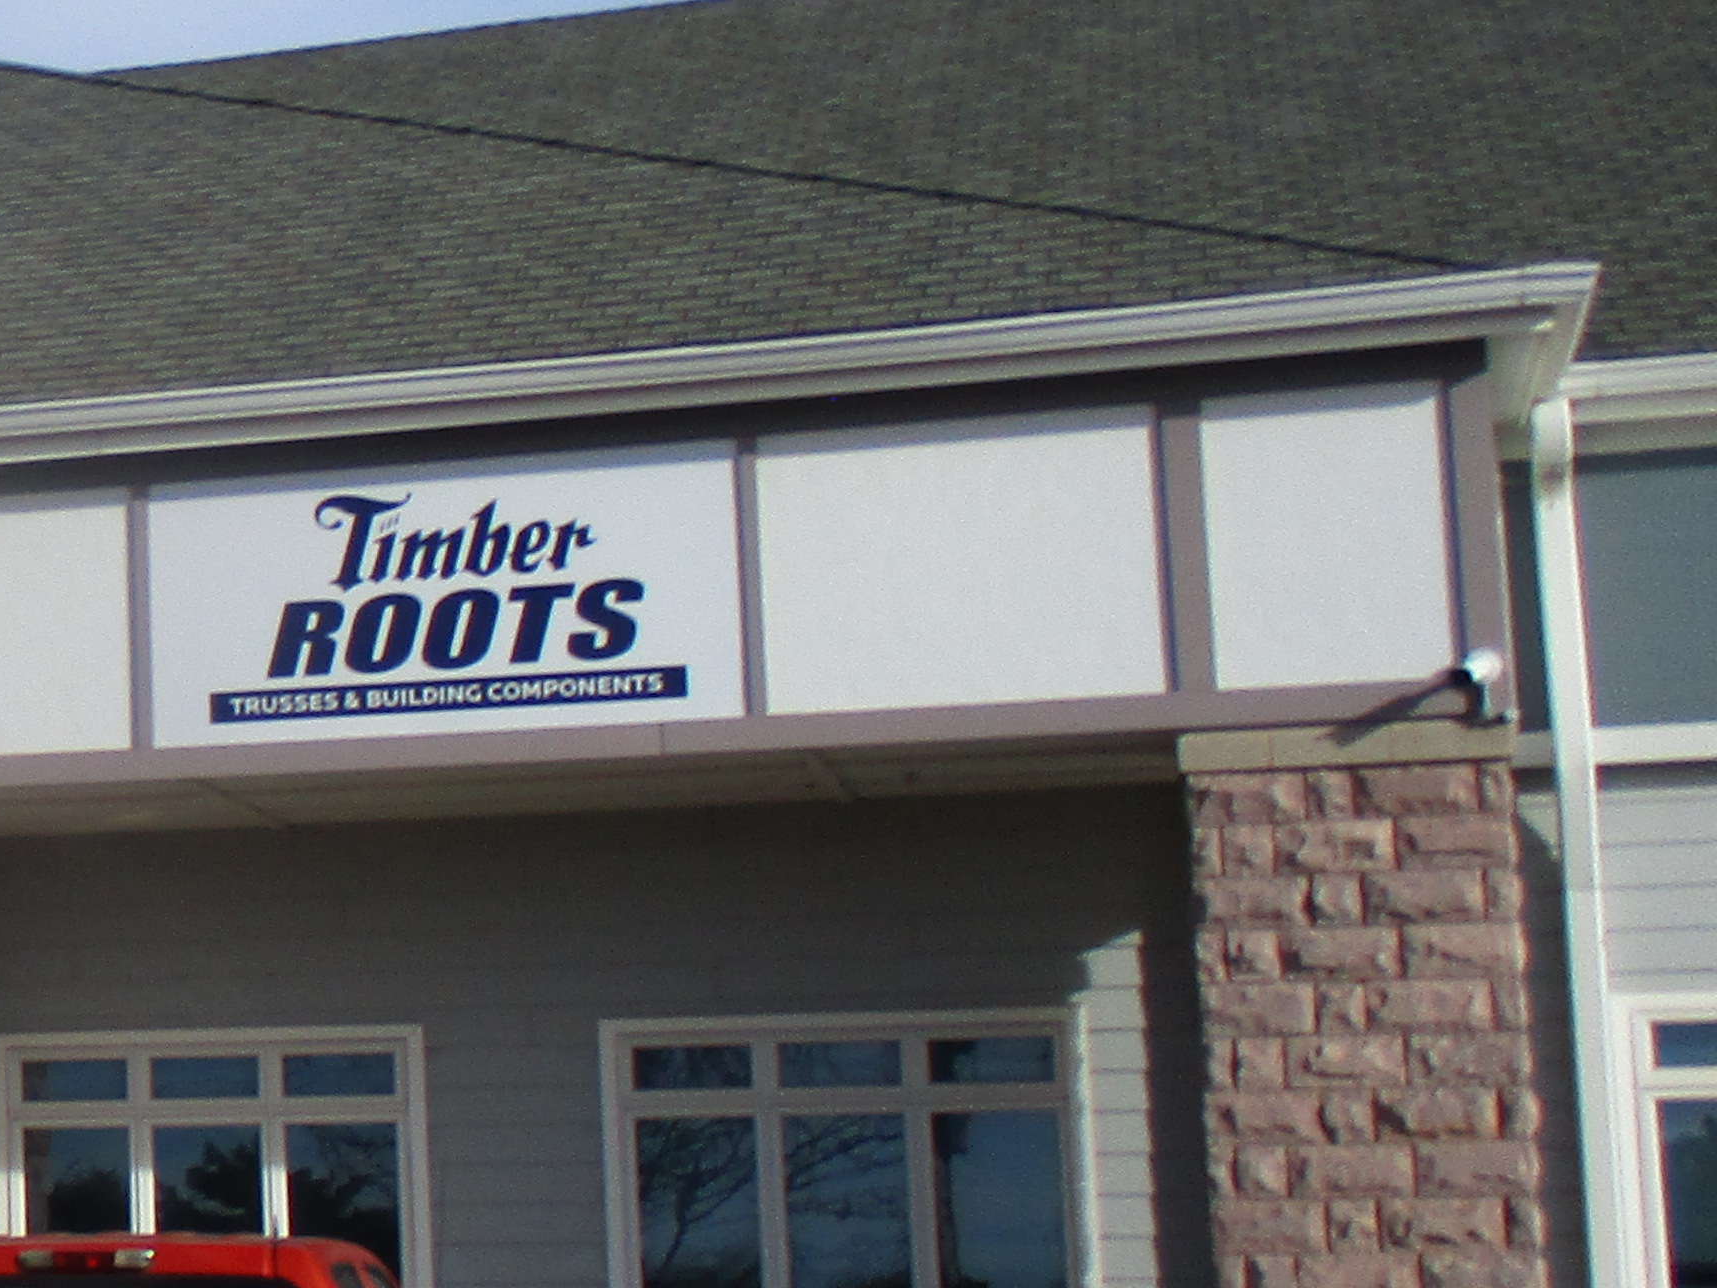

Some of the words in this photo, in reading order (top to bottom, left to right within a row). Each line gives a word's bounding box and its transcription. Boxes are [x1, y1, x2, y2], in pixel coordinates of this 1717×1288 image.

[313, 492, 598, 593] Timber
[266, 578, 646, 680] ROOTS
[229, 692, 340, 716] TRUSSES
[344, 691, 361, 710] &
[366, 684, 483, 710] BUILDING
[486, 673, 665, 703] COMPONENTS
